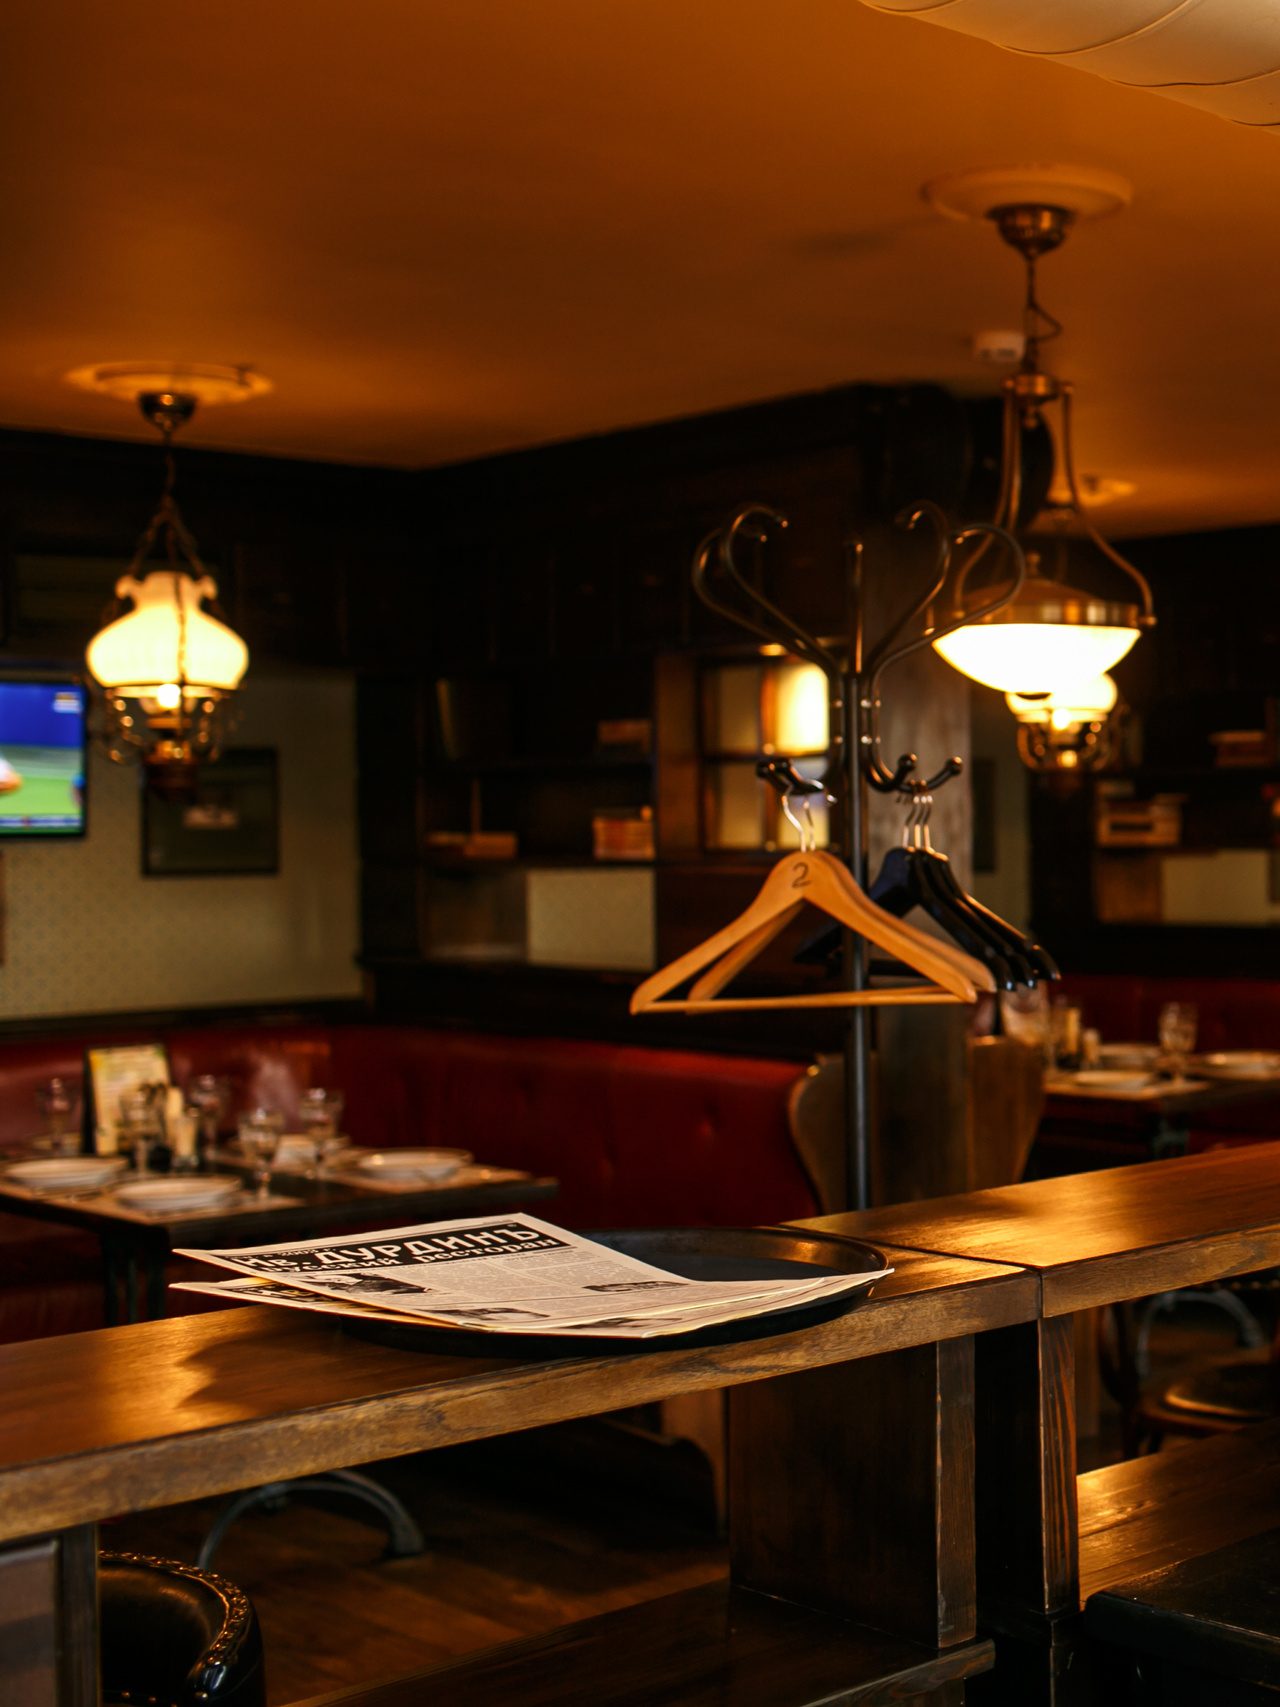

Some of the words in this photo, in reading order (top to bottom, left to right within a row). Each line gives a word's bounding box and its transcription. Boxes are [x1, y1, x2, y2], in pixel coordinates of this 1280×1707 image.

[792, 861, 812, 889] 2
[314, 1229, 540, 1264] ДУРДИНЪ
[412, 1238, 561, 1264] ресторан
